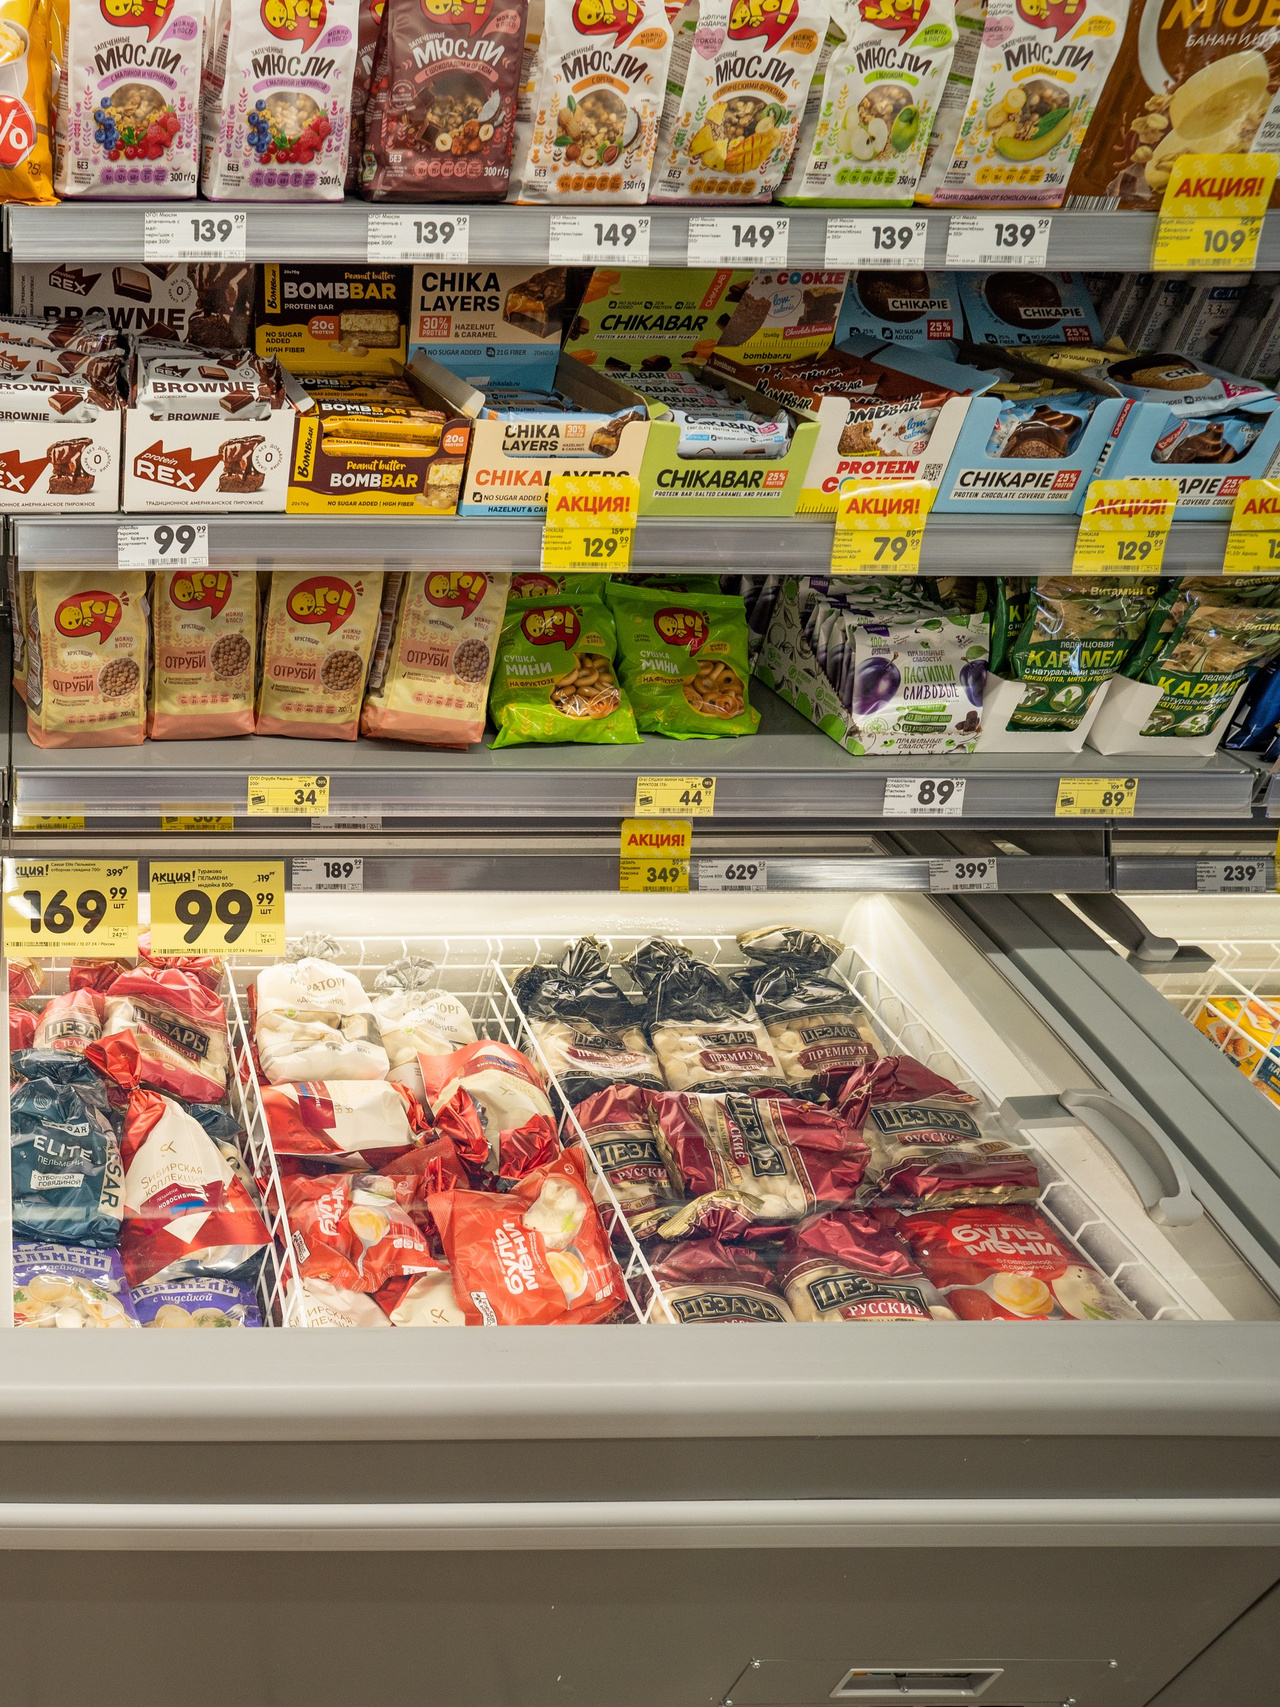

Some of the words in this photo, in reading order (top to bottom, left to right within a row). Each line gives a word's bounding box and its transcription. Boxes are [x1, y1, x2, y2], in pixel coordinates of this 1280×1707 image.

[94, 36, 130, 51] ЗАПЕЧЕННЫЕ
[1186, 34, 1236, 47] БАНАН
[412, 36, 505, 66] МЮСЛИ
[94, 46, 181, 76] МЮСЛИ
[252, 53, 334, 79] МЮСЛИ
[77, 162, 89, 170] БЕЗ
[1174, 178, 1264, 199] АКЦИЯ!
[191, 220, 232, 243] 139
[413, 222, 455, 245] 139
[594, 223, 637, 246] 149
[732, 225, 774, 248] 149
[872, 228, 913, 250] 139
[421, 273, 500, 291] CHIKA
[284, 283, 395, 300] BOMBBAR
[420, 296, 500, 312] LAYERS
[892, 300, 948, 309] CHIKAPIE
[421, 317, 448, 327] 30%
[455, 323, 495, 331] HAZELNUT
[599, 314, 709, 331] CHIKABAR
[743, 351, 791, 360] bombbar.ru
[142, 453, 177, 466] protein
[346, 461, 376, 472] Peanut
[378, 461, 406, 472] butter
[836, 460, 919, 474] PROTEIN
[330, 473, 418, 488] BOMBBAR
[767, 472, 786, 481] 25%
[555, 495, 630, 513] АКЦИЯ!
[846, 498, 920, 515] АКЦИЯ!
[1093, 497, 1167, 514] АКЦИЯ!
[153, 526, 196, 555] 99
[583, 537, 617, 558] 129
[873, 537, 907, 561] 79
[165, 655, 206, 669] ОТРУБИ
[504, 655, 535, 664] СУШКА
[506, 663, 552, 676] МИНИ
[904, 666, 956, 684] ПАСТИЛКИ
[903, 683, 959, 701] СЛИВОВЫЕ
[294, 789, 317, 805] 34
[679, 790, 702, 805] 44
[917, 780, 954, 807] 89
[324, 862, 353, 879] 189
[646, 867, 679, 883] 349
[725, 864, 758, 879] 629
[954, 863, 987, 879] 399
[1224, 866, 1256, 882] 239
[22, 889, 107, 934] 169
[109, 887, 127, 899] 99
[174, 889, 253, 944] 99
[256, 892, 274, 904] 99
[135, 1008, 208, 1052] ЦЕЗАРЬ
[803, 1027, 859, 1041] ЦЕЗАРЬ
[809, 1046, 868, 1061] ПРЕМИУМ
[33, 1135, 92, 1160] ELITE
[37, 1156, 84, 1168] ПЕЛЬМЕНИ
[952, 1225, 1045, 1242] буль
[967, 1240, 1063, 1256] мени
[848, 1302, 923, 1316] РУССКИЕ
